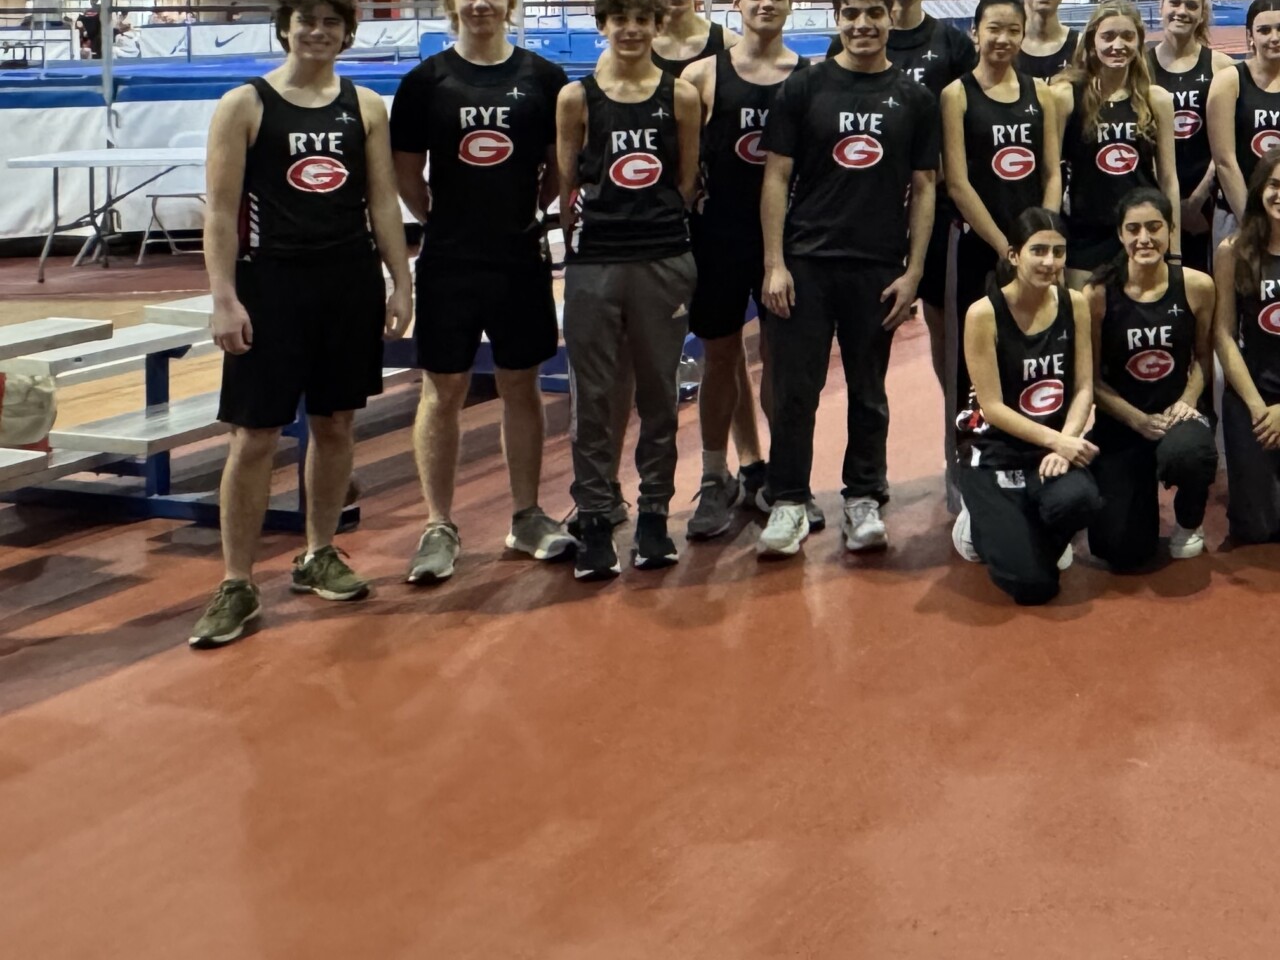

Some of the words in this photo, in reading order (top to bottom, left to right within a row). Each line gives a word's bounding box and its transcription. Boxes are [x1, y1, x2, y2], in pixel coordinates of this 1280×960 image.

[460, 106, 510, 129] RYE
[740, 108, 769, 129] RY
[839, 111, 883, 134] RYE
[289, 132, 343, 155] RYE
[611, 128, 658, 154] RYE
[992, 123, 1032, 146] RYE
[1097, 122, 1136, 143] RYE
[1127, 325, 1173, 350] RYE
[1023, 353, 1064, 381] RYE
